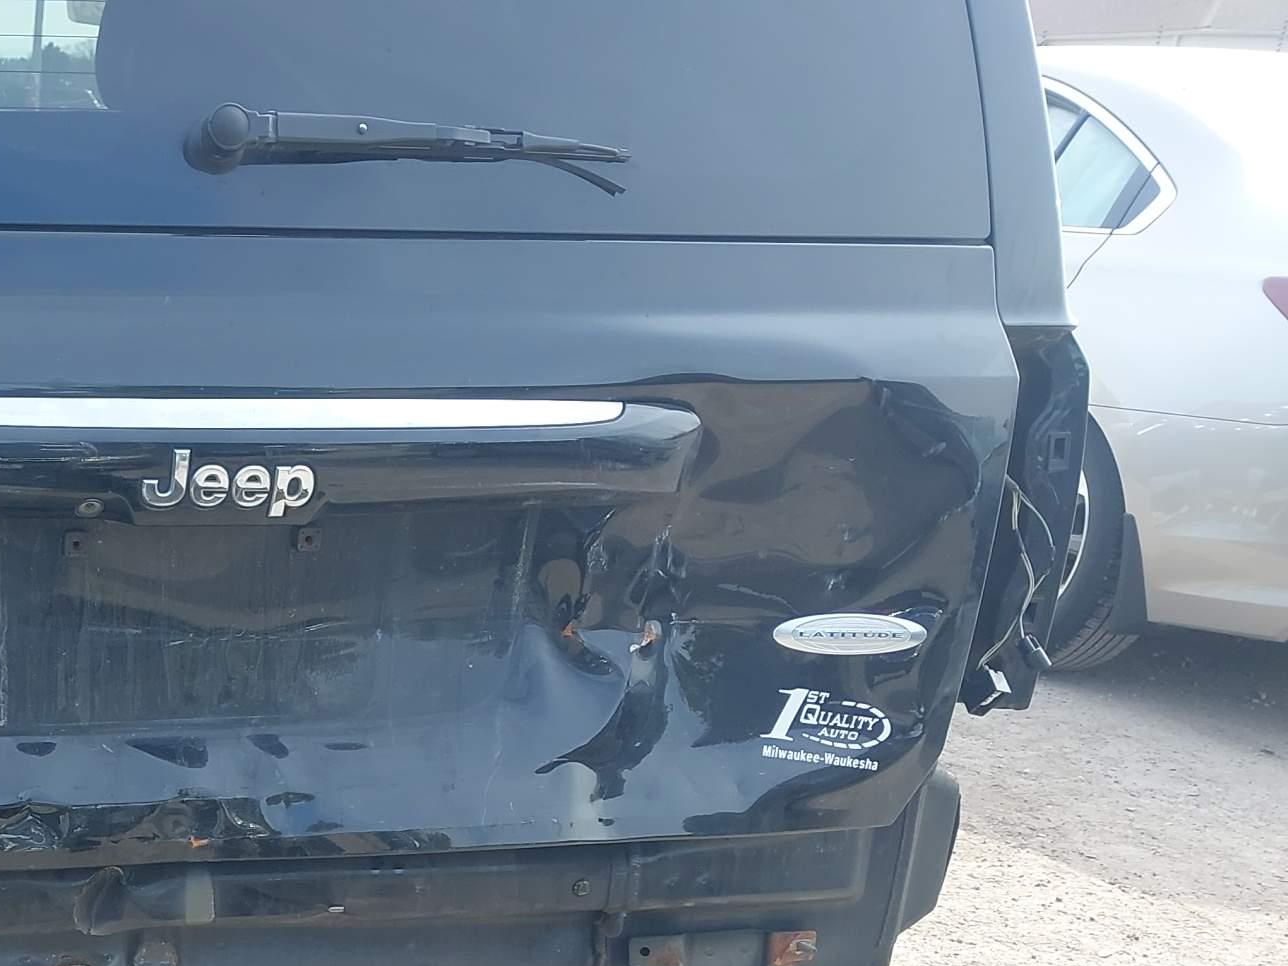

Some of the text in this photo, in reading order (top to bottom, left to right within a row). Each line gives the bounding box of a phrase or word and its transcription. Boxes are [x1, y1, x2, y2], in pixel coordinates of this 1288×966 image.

[141, 448, 315, 518] Jeep
[798, 630, 905, 640] LATITUDE
[799, 704, 880, 731] QUALITY
[817, 728, 859, 741] AUTO
[762, 745, 880, 772] Milwaukee-Waukesha
